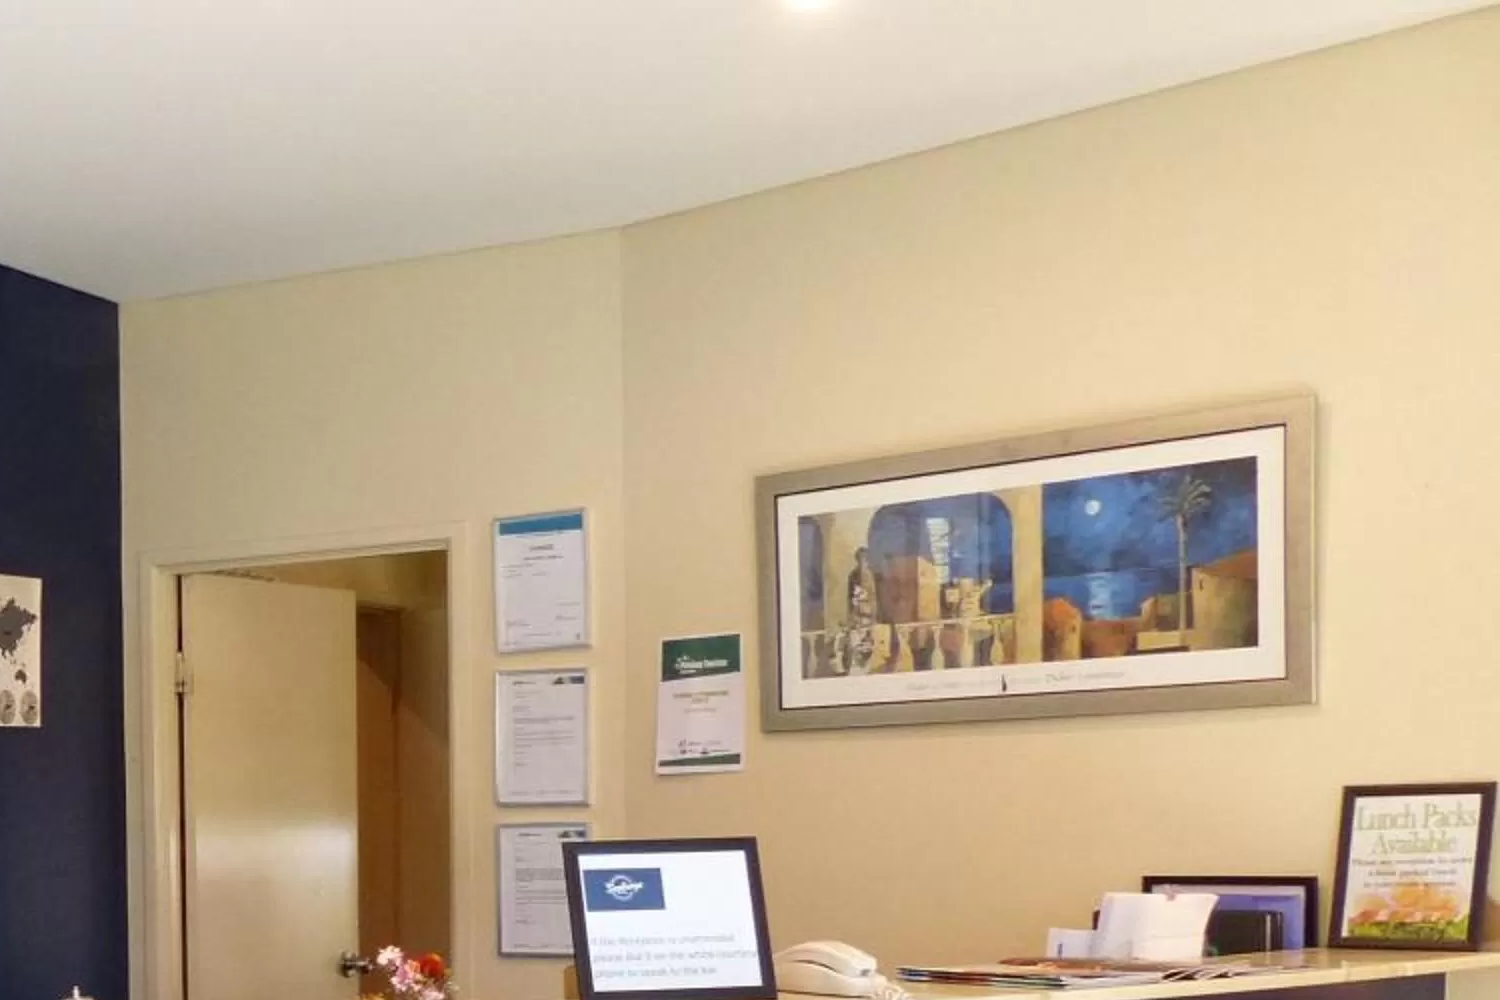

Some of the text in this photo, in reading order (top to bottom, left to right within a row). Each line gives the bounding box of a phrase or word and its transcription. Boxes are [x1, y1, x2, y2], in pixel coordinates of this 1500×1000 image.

[1356, 800, 1477, 831] Lunch Packs
[1370, 829, 1457, 855] Available
